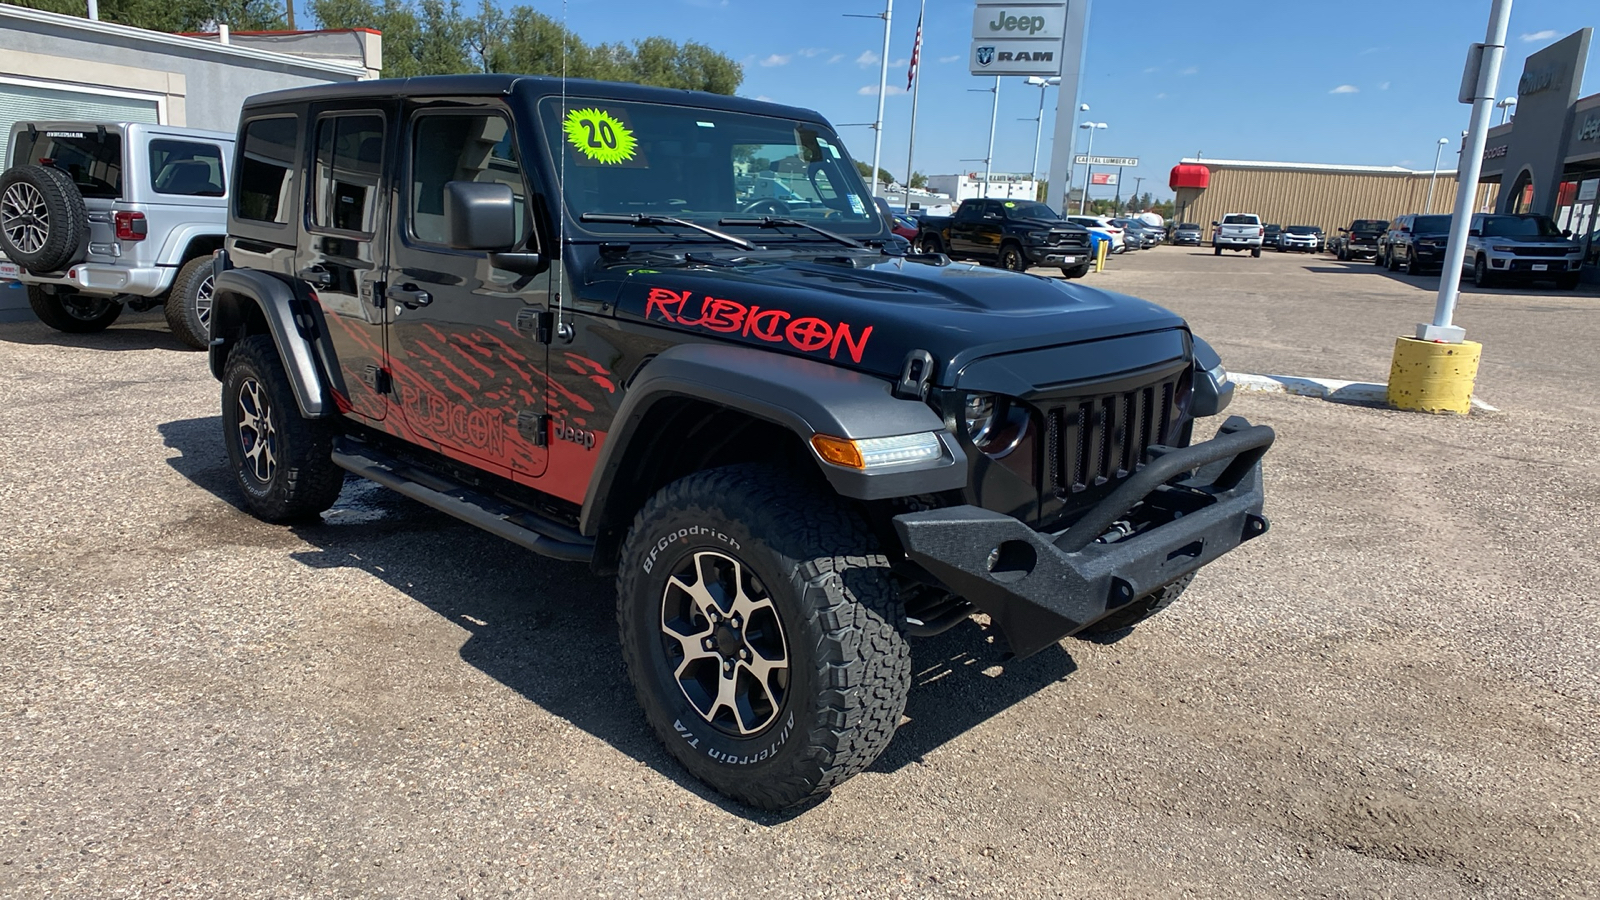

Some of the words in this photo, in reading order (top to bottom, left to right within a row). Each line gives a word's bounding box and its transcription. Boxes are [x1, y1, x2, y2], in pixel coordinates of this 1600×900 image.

[989, 11, 1045, 35] Jeep
[998, 51, 1053, 62] RAM
[579, 119, 617, 149] 20
[645, 288, 873, 364] RUBICON
[402, 385, 506, 457] RUBICON
[554, 419, 596, 451] Jeep
[642, 524, 742, 575] BFGoodrich
[673, 719, 701, 749] T/A
